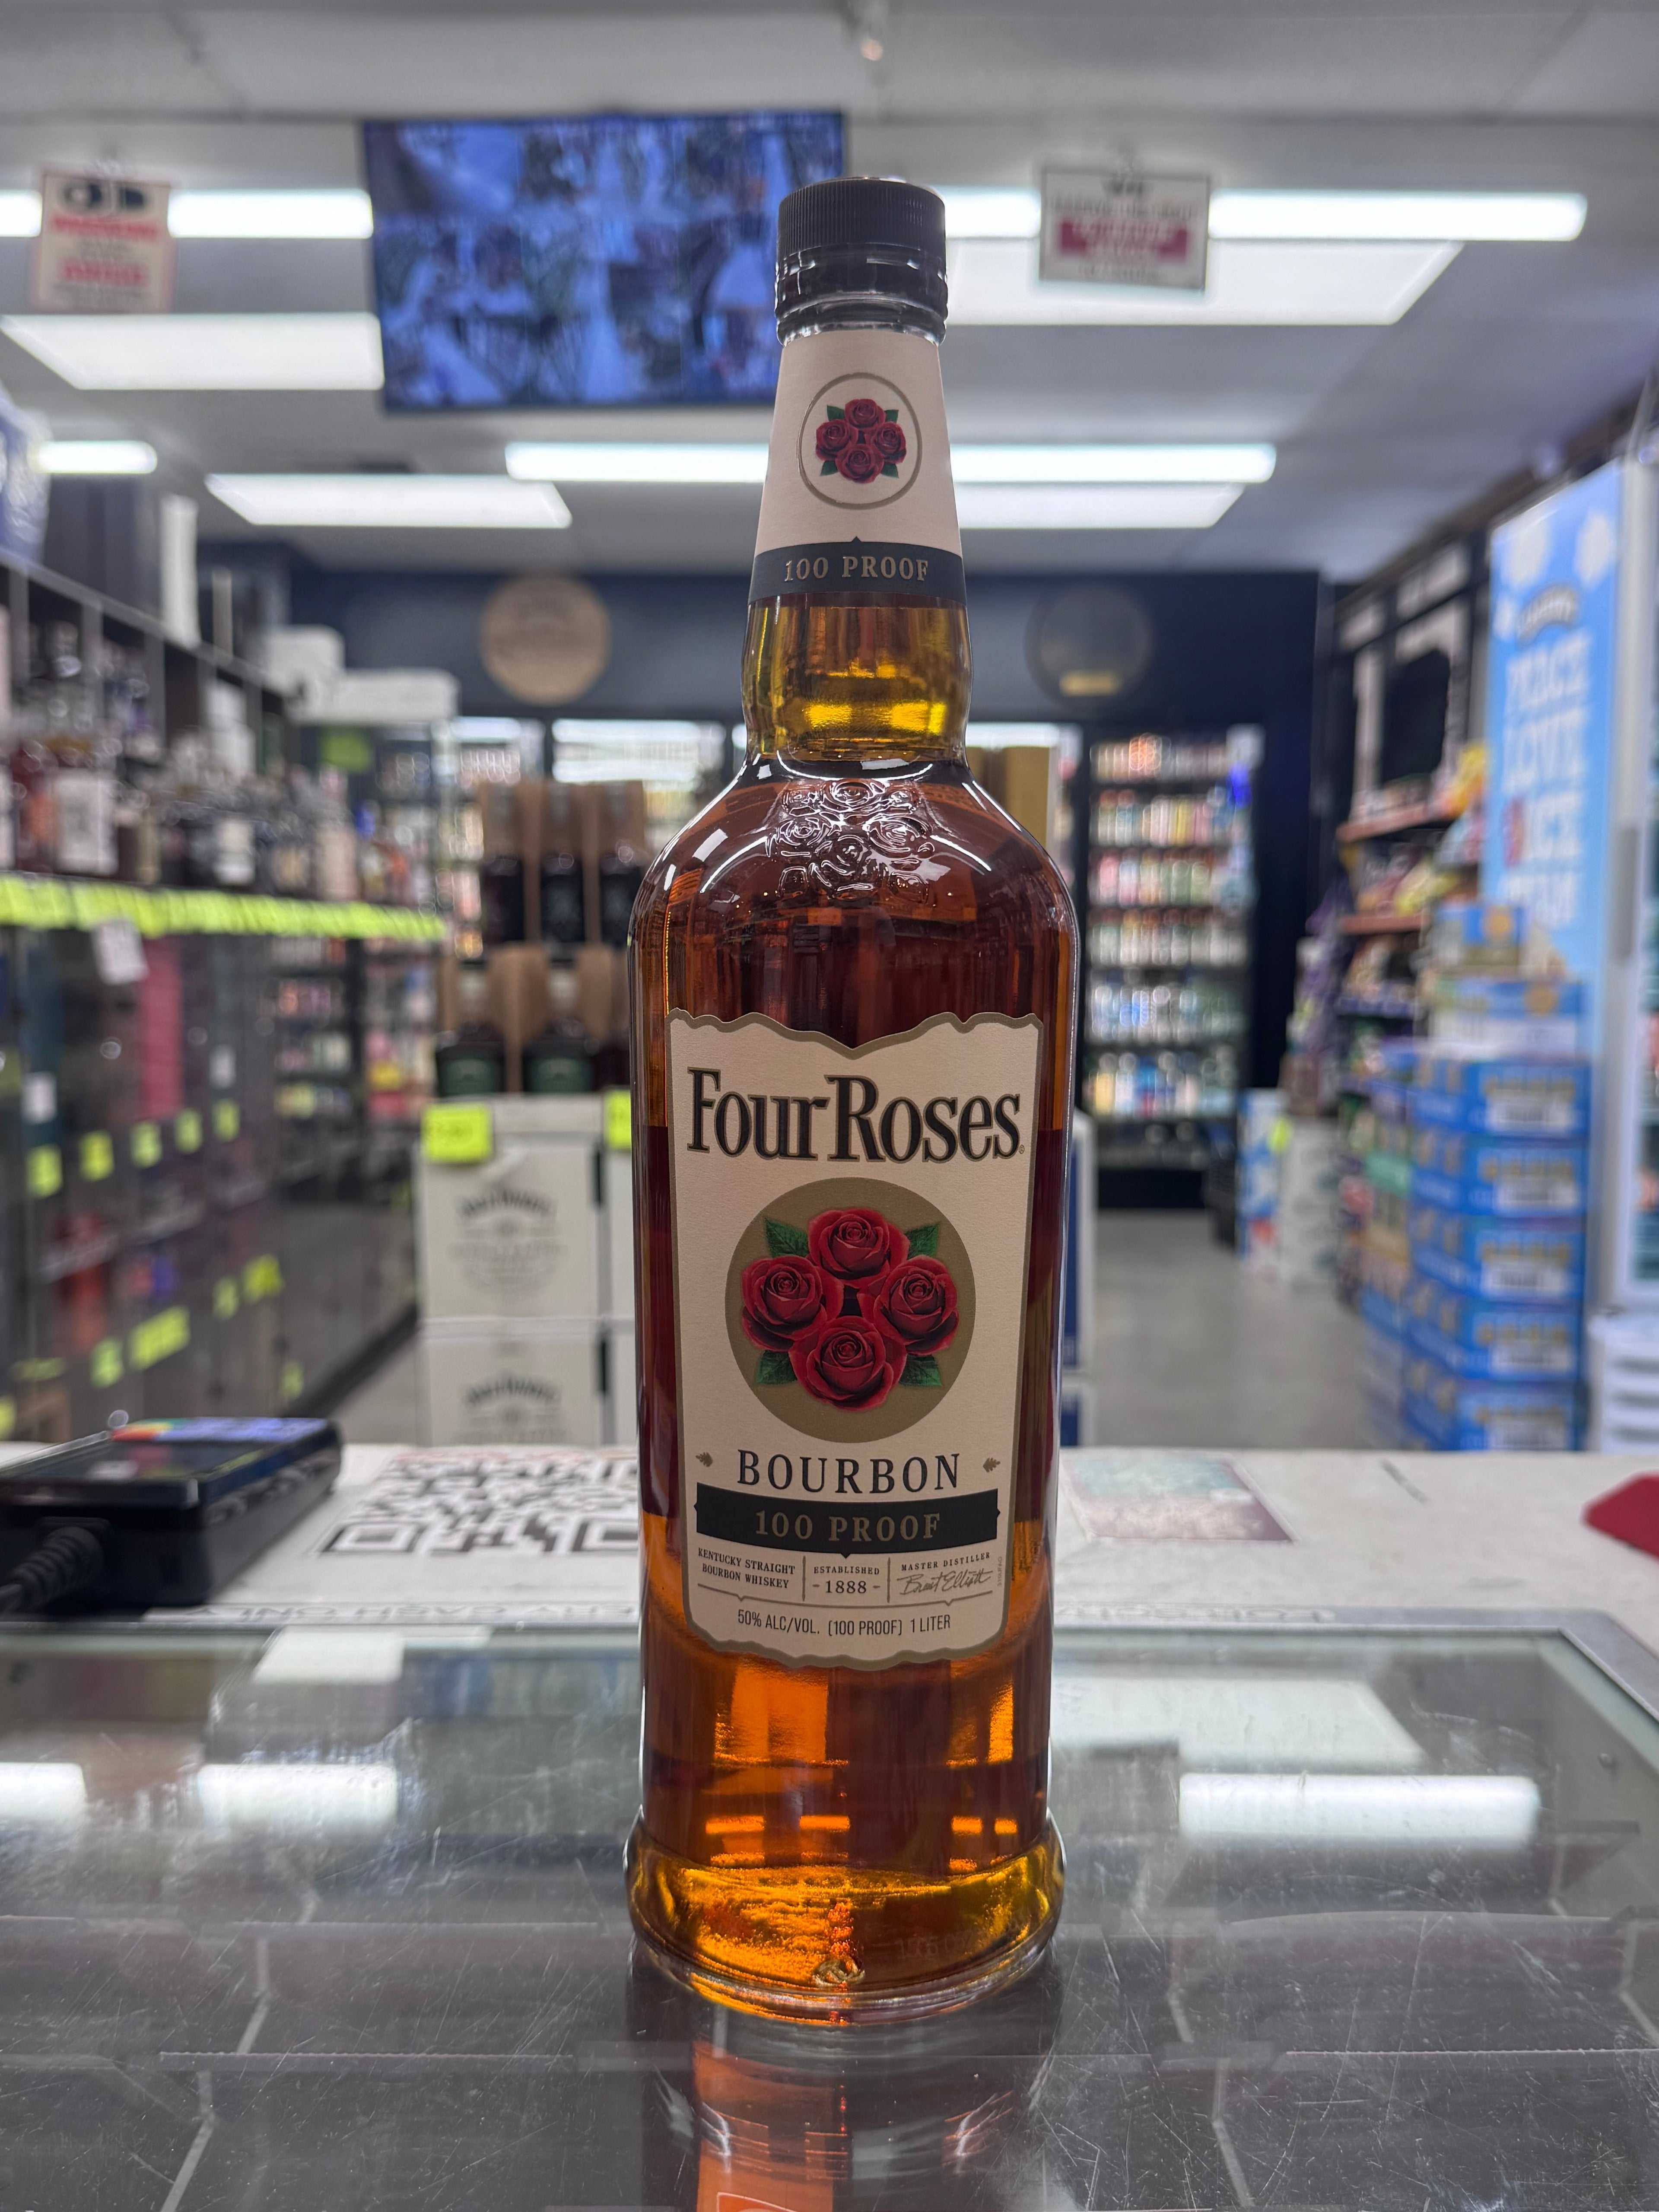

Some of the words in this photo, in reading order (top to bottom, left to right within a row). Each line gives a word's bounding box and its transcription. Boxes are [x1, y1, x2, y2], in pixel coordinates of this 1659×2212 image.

[785, 557, 829, 582] 100
[842, 556, 928, 581] PROOF
[687, 1066, 831, 1162] Four
[823, 1074, 1021, 1163] Roses
[737, 1449, 960, 1494] BOURBON
[755, 1510, 813, 1540] 100
[828, 1513, 940, 1542] PROOF
[698, 1547, 742, 1567] KENTUCKY
[745, 1559, 795, 1575] STRAIGHT
[814, 1566, 880, 1575] ESTABLISHED
[901, 1561, 938, 1571] MASTER
[943, 1551, 990, 1567] DISTILLER
[702, 1563, 741, 1582] BOURBON
[745, 1573, 789, 1589] WHISKEY
[825, 1580, 867, 1594] 1888
[737, 1609, 762, 1627] 50%
[765, 1614, 820, 1634] ALC/VOL.
[828, 1619, 855, 1637] (100
[858, 1619, 903, 1636] PROOF)
[909, 1618, 915, 1633] 1
[919, 1614, 950, 1632] LITER
